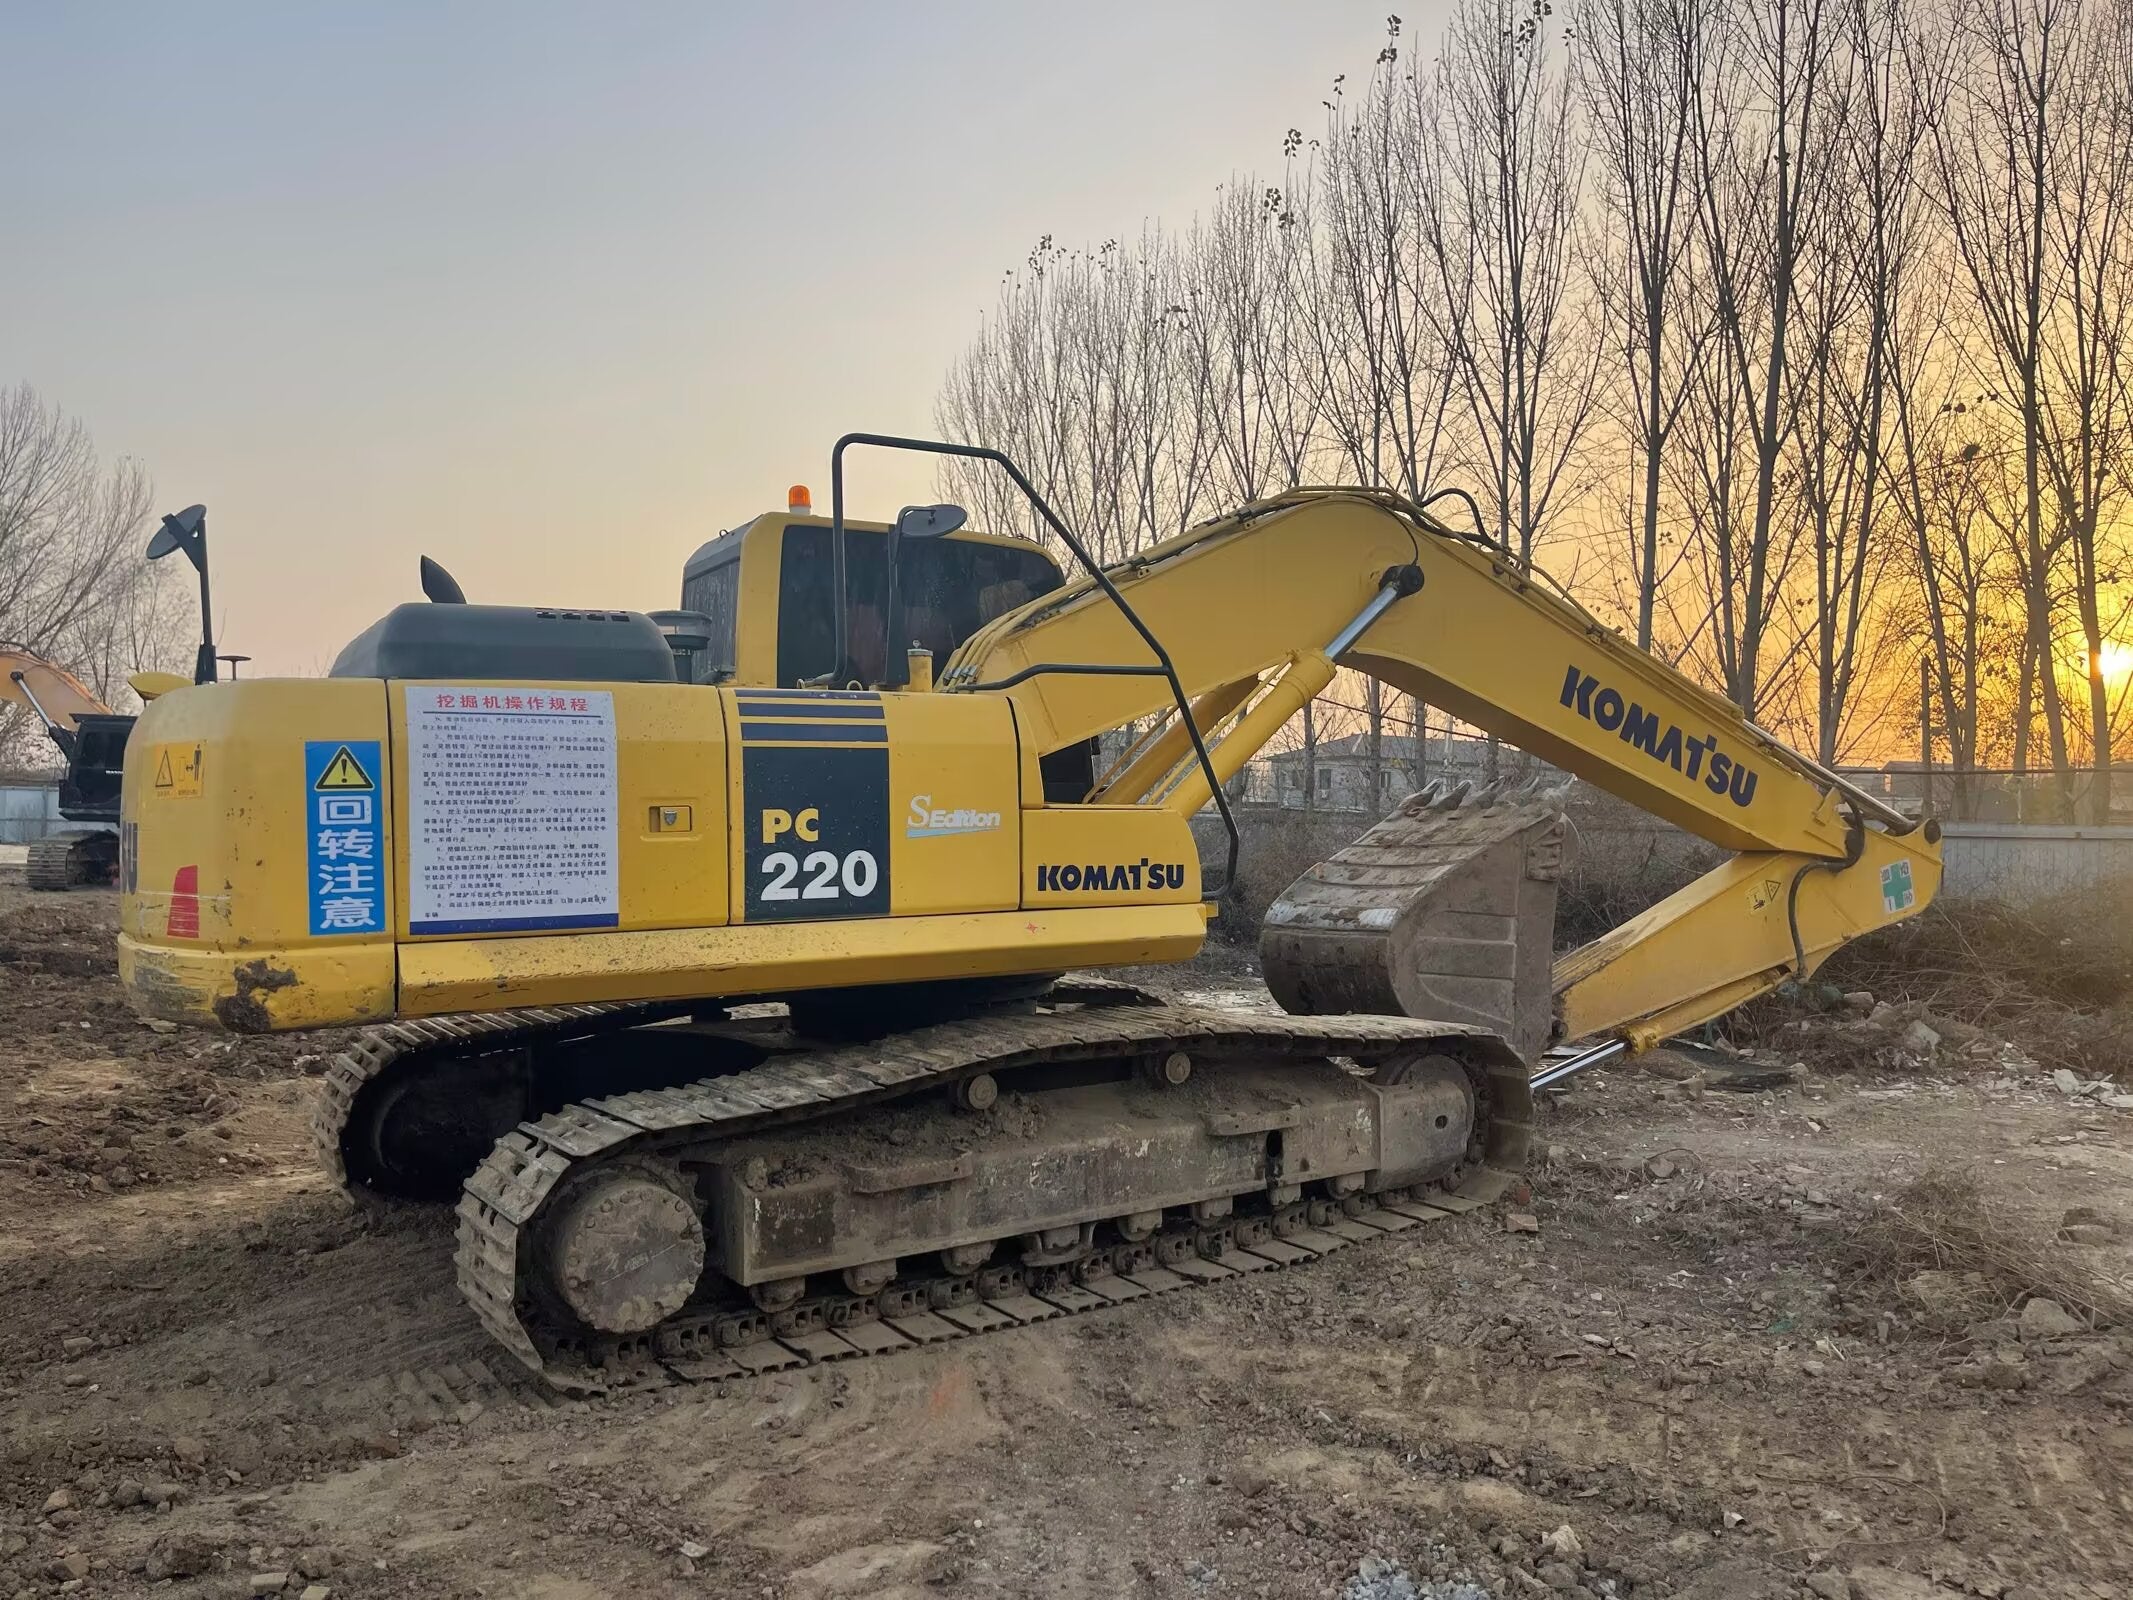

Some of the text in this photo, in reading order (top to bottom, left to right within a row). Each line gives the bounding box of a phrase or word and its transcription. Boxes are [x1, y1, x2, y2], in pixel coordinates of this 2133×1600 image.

[437, 694, 589, 712] 挖掘机操作规程
[1559, 664, 1759, 808] KOMATSU
[762, 808, 820, 844] PC
[317, 795, 376, 930] 回转注意
[760, 849, 879, 901] 220
[1037, 857, 1185, 892] KOMATSU
